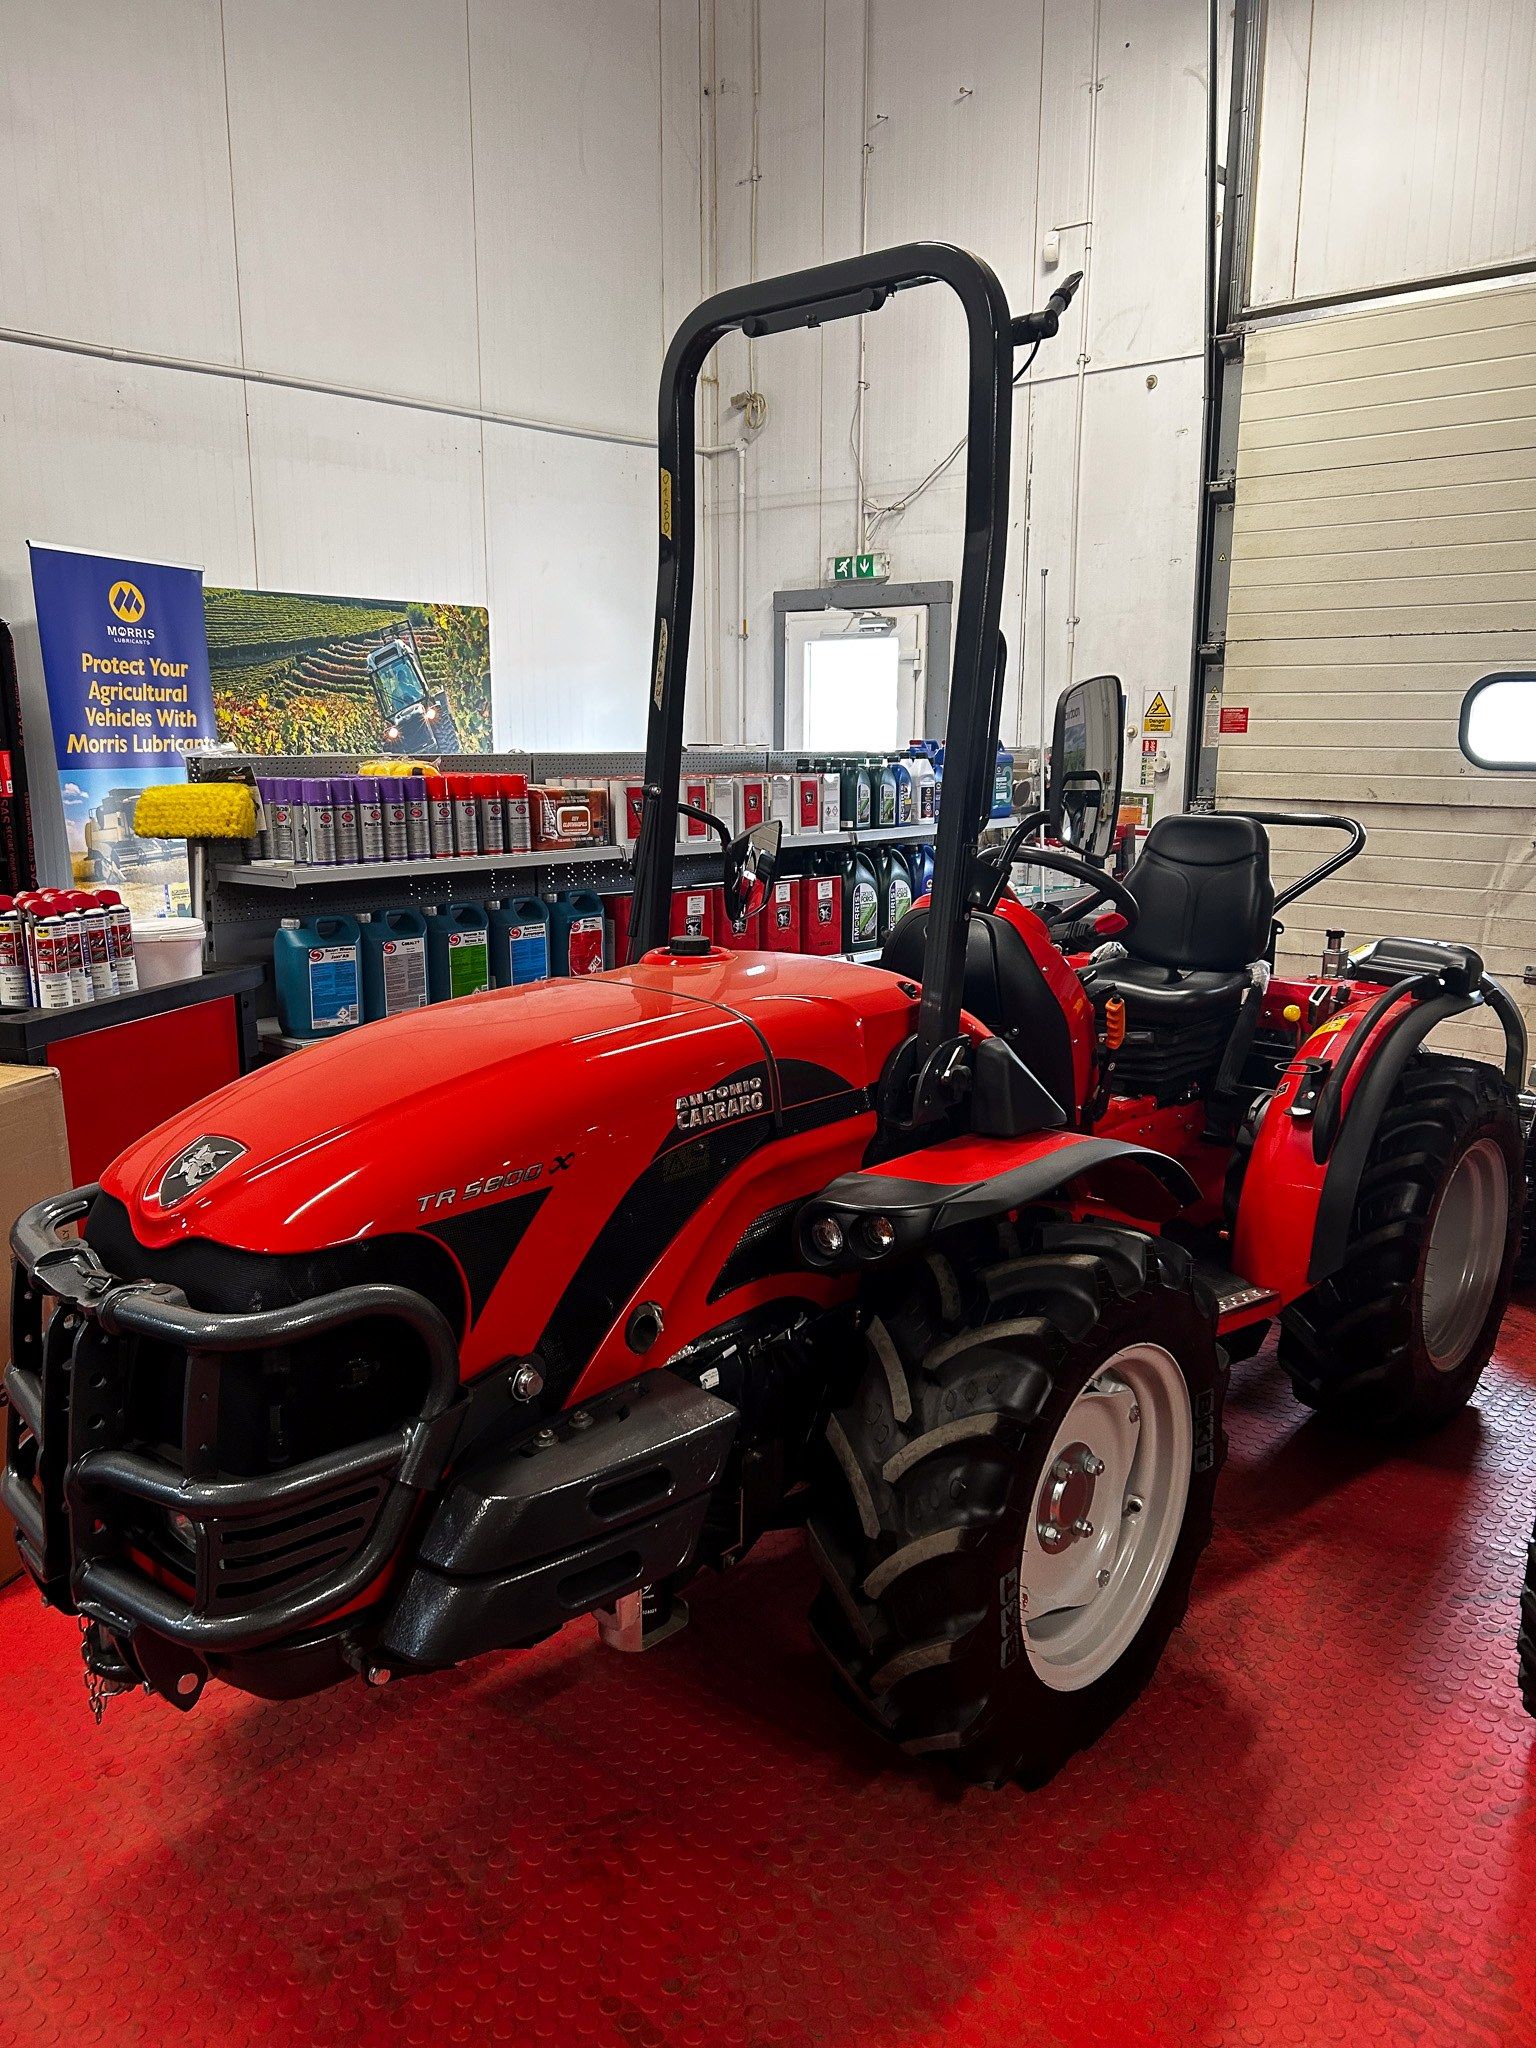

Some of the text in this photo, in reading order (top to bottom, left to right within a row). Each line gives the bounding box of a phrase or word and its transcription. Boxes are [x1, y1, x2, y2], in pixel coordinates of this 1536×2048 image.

[107, 625, 155, 639] MORRIS
[114, 637, 151, 646] LUBRICANTS
[81, 652, 189, 678] Protect Your
[88, 680, 188, 707] Agricultural
[84, 706, 197, 728] Vehicles With
[66, 733, 215, 754] Morris Lubricants
[0, 799, 11, 824] SAS
[675, 1077, 762, 1110] ANTONIO
[676, 1091, 763, 1131] CARRARO
[417, 1188, 456, 1212] TR
[462, 1163, 543, 1201] 5800
